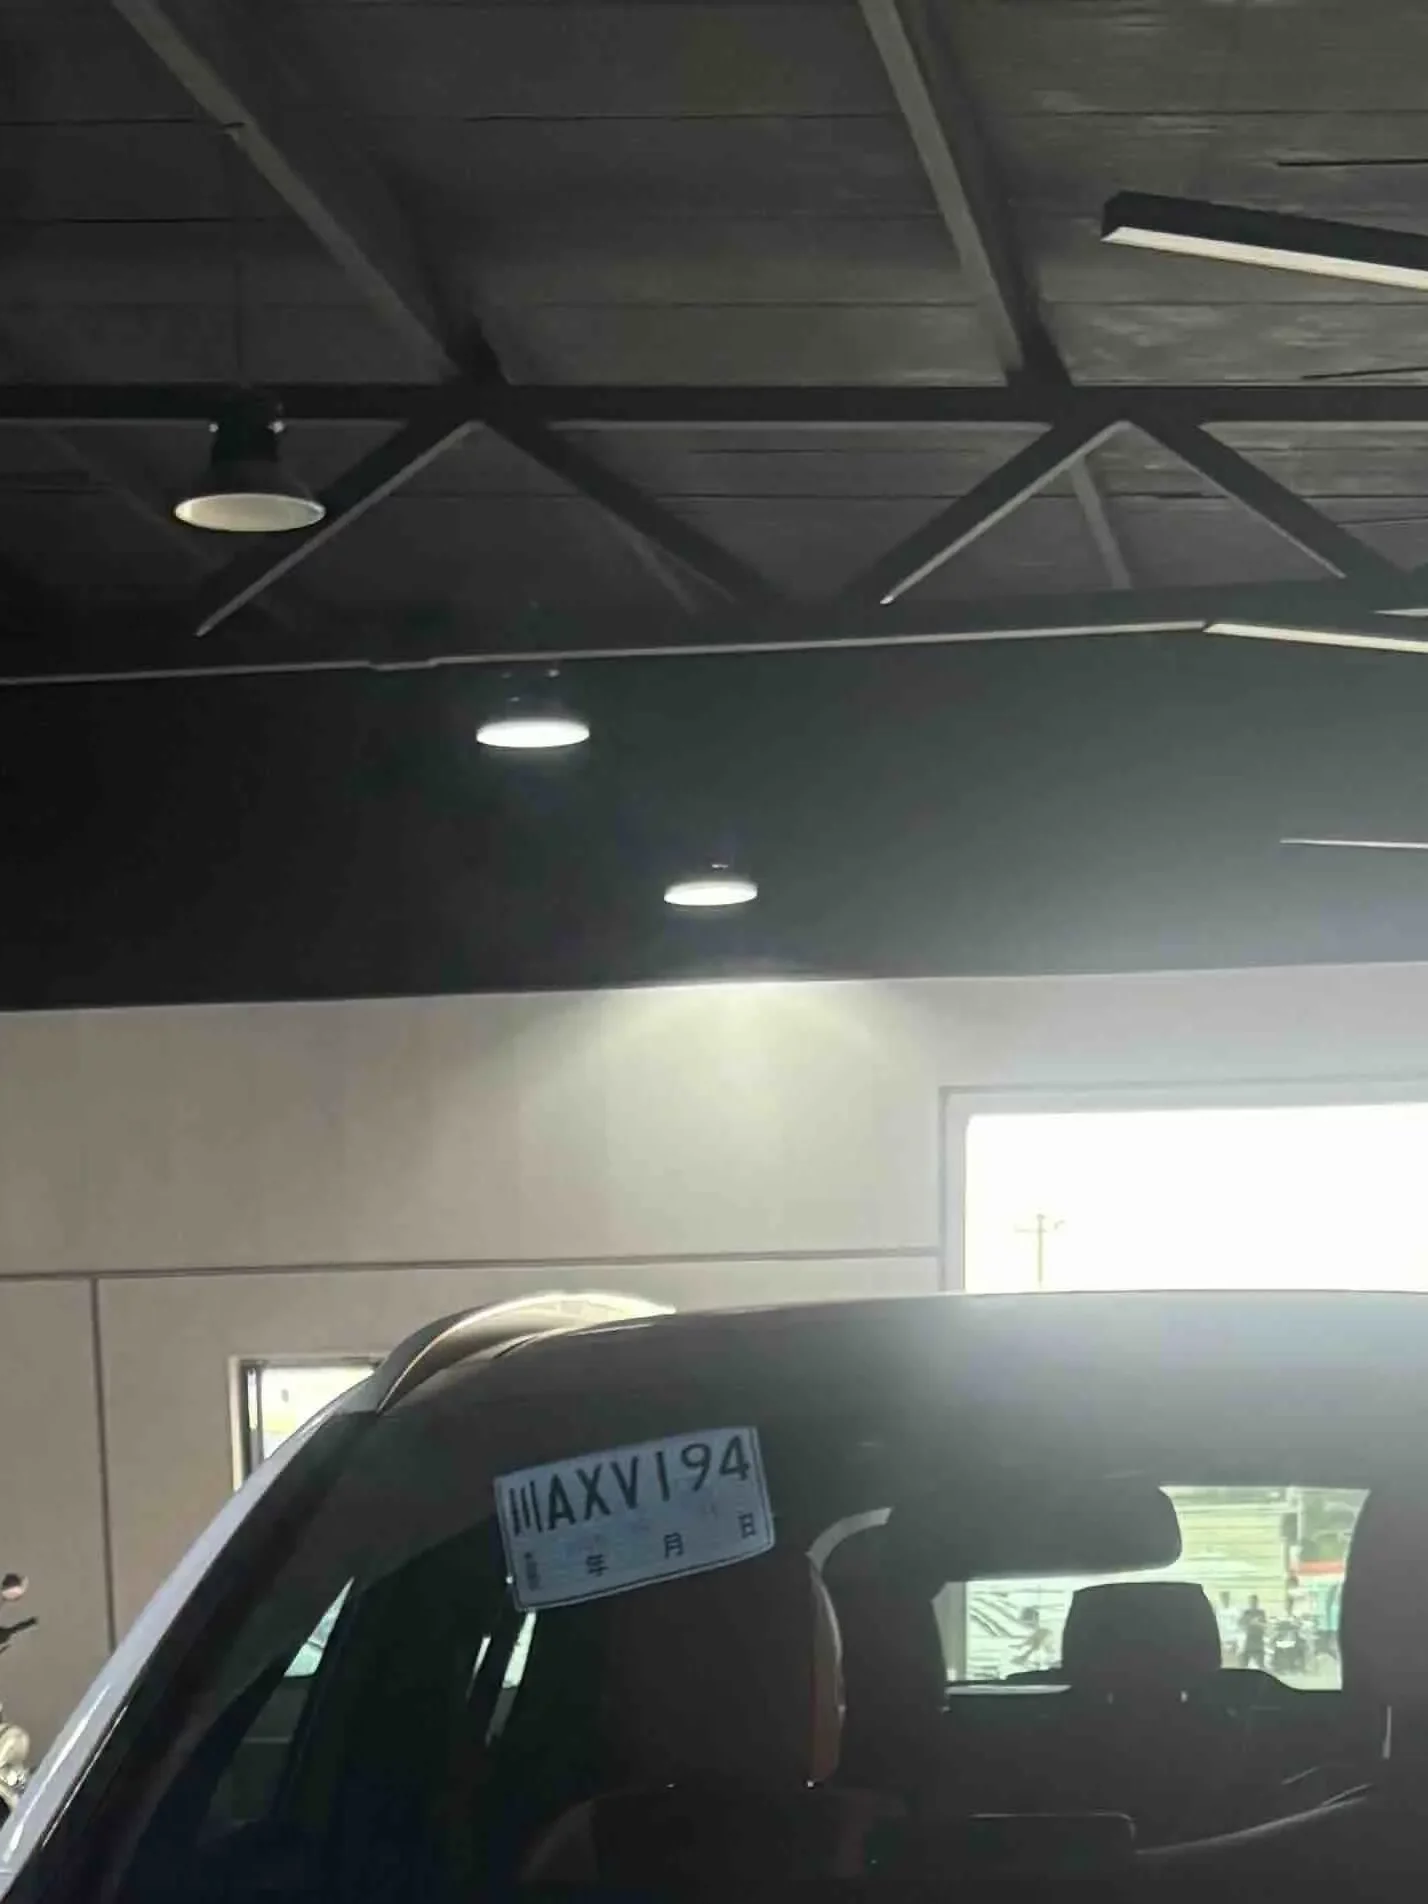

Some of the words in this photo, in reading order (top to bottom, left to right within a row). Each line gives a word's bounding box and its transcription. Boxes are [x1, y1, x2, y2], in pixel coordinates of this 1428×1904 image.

[584, 1553, 609, 1577] 年
[663, 1532, 685, 1560] 月
[737, 1512, 757, 1539] 日
